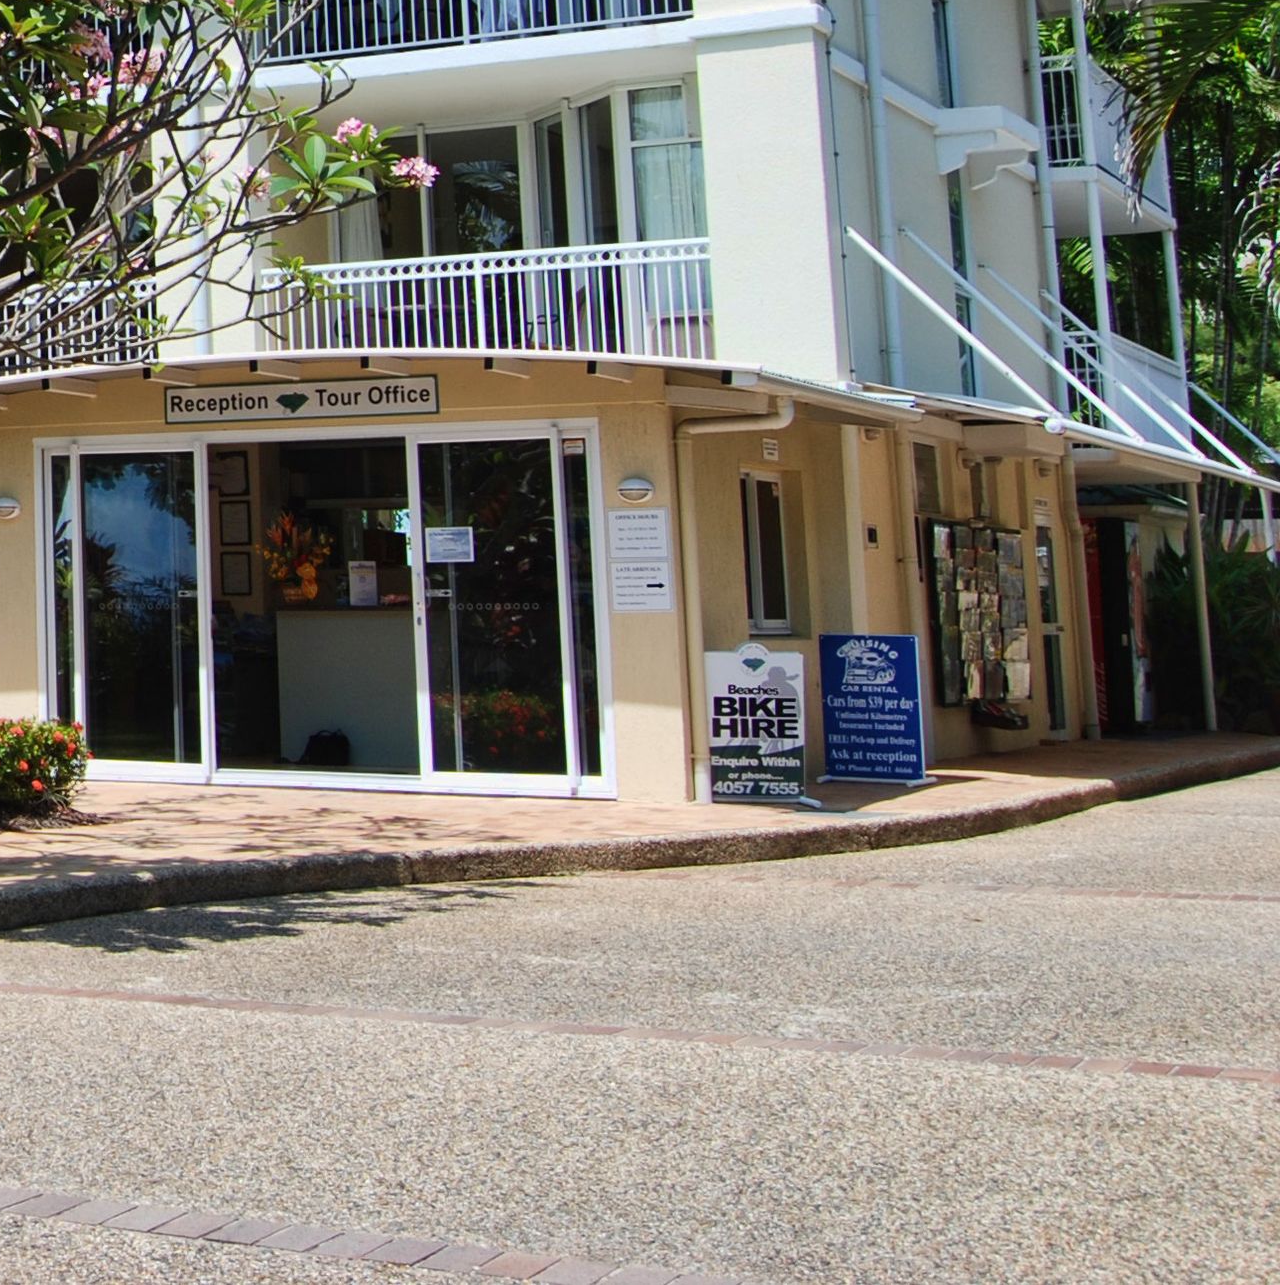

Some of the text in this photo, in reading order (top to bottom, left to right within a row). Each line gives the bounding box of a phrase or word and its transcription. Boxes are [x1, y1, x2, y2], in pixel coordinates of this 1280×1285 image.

[170, 385, 431, 415] Reception Tour Office
[727, 684, 779, 696] Beaches
[841, 684, 898, 693] CAR RENTAL
[713, 696, 797, 718] BIKE
[827, 695, 914, 712] Cars from $39 per day
[835, 711, 869, 720] Unlimited
[712, 718, 799, 739] HIRE
[874, 722, 905, 731] Included
[876, 736, 888, 745] and
[890, 736, 916, 747] Delivery
[711, 755, 801, 768] Enquire Within
[830, 749, 917, 764] Ask at reception
[728, 772, 738, 780] or
[712, 780, 800, 795] 4057 7555
